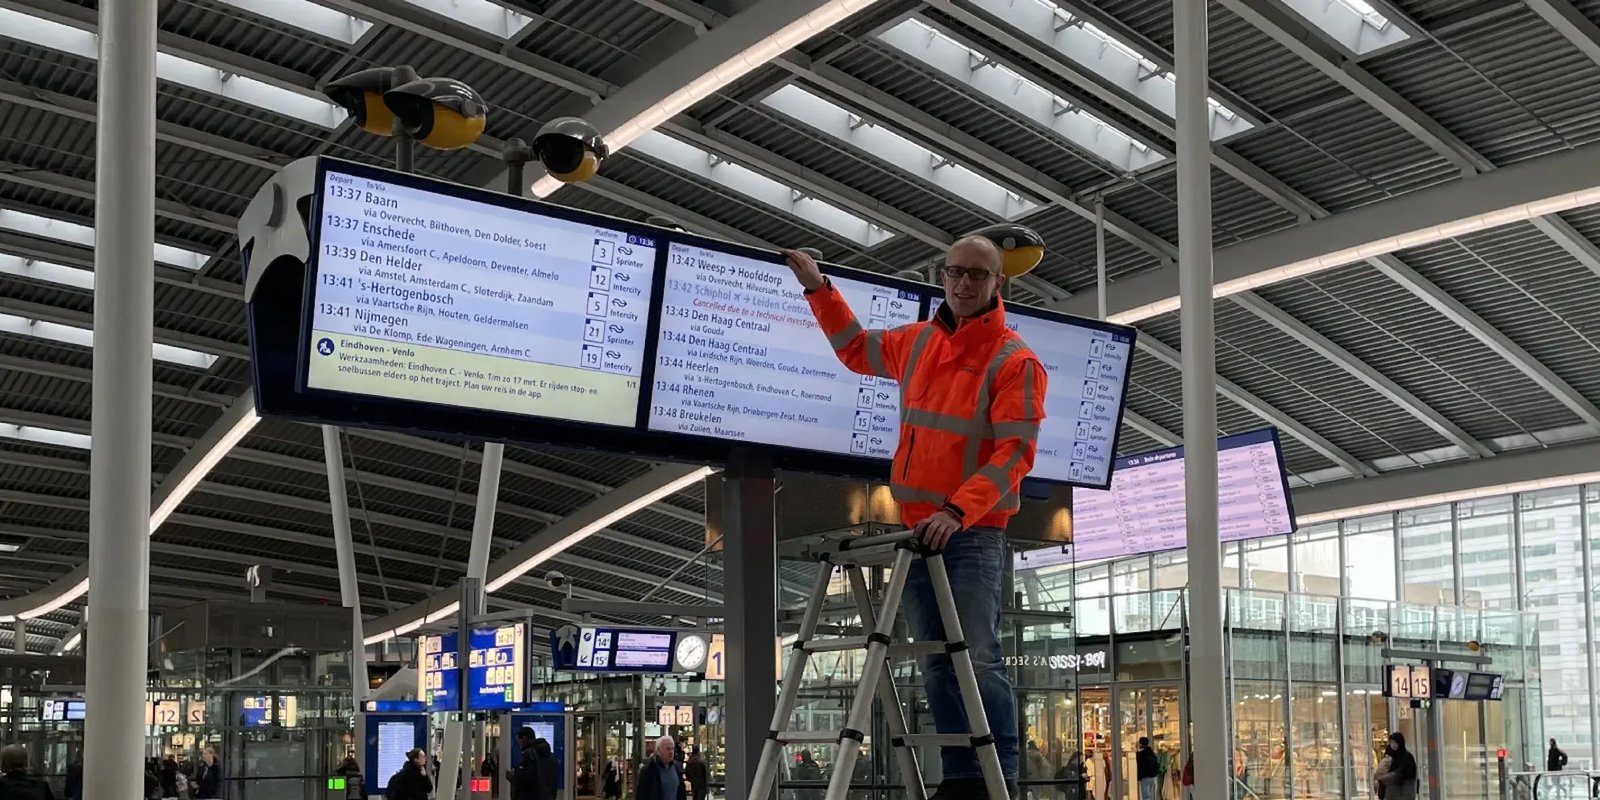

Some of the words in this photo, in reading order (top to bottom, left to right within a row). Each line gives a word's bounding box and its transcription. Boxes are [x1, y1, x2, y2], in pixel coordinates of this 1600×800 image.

[330, 174, 353, 184] Depart
[331, 185, 361, 200] 13:37
[365, 192, 398, 208] Baarn
[328, 215, 359, 230] 13:37
[363, 221, 415, 241] Enschede
[364, 208, 377, 218] via
[380, 210, 426, 229] Overvecht,
[430, 220, 472, 238] Bilthoven,
[475, 229, 491, 240] Den
[493, 232, 521, 247] Dolder,
[524, 239, 546, 251] Soest
[326, 245, 356, 260] 13:39
[360, 250, 382, 264] Den
[386, 255, 422, 271] Helder
[361, 237, 374, 247] via
[377, 240, 427, 257] Amersfoort
[442, 252, 488, 269] Apeldoorn,
[491, 260, 529, 276] Deventer,
[531, 269, 559, 281] Almelo
[600, 248, 606, 258] 3
[616, 257, 643, 268] Sprinter
[672, 254, 695, 267] 13:42
[698, 259, 726, 275] Weesp
[738, 267, 782, 287] Hoofddorp
[596, 274, 606, 285] 12
[708, 275, 743, 290] Overvecht,
[323, 274, 352, 288] 13:41
[359, 279, 453, 305] 's-Hertogenbosch
[359, 268, 372, 276] via
[374, 268, 406, 283] Amstel,
[409, 275, 458, 290] Amsterdam
[474, 285, 515, 302] Sloterdijk,
[517, 293, 553, 307] Zaandam
[613, 284, 641, 296] Intercity
[669, 279, 692, 293] 13:42
[695, 284, 731, 300] Schiphol
[752, 296, 779, 309] Leiden
[595, 301, 600, 311] 5
[693, 298, 728, 311] Cancelled
[728, 305, 740, 314] due
[756, 310, 785, 321] technical
[878, 303, 881, 311] 1
[320, 303, 349, 317] 13:41
[355, 308, 408, 327] Nijmegen
[372, 297, 414, 311] Vaartsche
[417, 304, 435, 316] Rijn,
[438, 308, 471, 322] Houten,
[474, 314, 528, 330] Geldermalsen
[610, 309, 638, 322] Intercity
[666, 305, 689, 318] 13:43
[692, 310, 708, 321] Den
[711, 314, 733, 328] Haag
[735, 318, 770, 332] Centraal
[589, 327, 599, 337] 21
[702, 325, 724, 336] Gouda
[354, 325, 367, 333] via
[369, 325, 381, 335] De
[384, 328, 413, 341] Klomp,
[416, 332, 488, 352] Ede-Wageningen,
[491, 344, 522, 356] Arnhem
[607, 335, 634, 345] Sprinter
[663, 331, 686, 343] 13:44
[689, 335, 706, 346] Den
[708, 338, 730, 353] Haag
[732, 342, 767, 357] Centraal
[341, 340, 384, 353] Eindhoven
[392, 347, 415, 357] Venlo
[587, 353, 597, 364] 19
[660, 356, 683, 368] 13:44
[686, 360, 719, 374] Heerlen
[699, 350, 728, 361] Leidsche
[801, 366, 836, 379] Zoetermeer
[339, 352, 406, 368] Werkzaamheden:
[408, 362, 447, 374] Eindhoven
[540, 380, 547, 388] Er
[548, 383, 569, 391] rijden
[571, 385, 585, 394] stop-
[604, 361, 632, 372] Intercity
[1091, 366, 1095, 374] 7
[338, 366, 381, 376] snelbussen
[383, 370, 407, 380] elders
[409, 375, 419, 383] op
[421, 375, 433, 384] het
[464, 381, 479, 389] Plan
[657, 381, 680, 393] 13:44
[682, 385, 714, 398] Rhenen
[756, 384, 790, 395] Eindhoven
[800, 390, 832, 402] Roermond
[1086, 387, 1093, 395] 12
[693, 399, 725, 411] Vaartsche
[862, 395, 870, 404] 18
[654, 406, 677, 418] 13:48
[680, 409, 722, 423] Breukelen
[859, 418, 867, 427] 15
[714, 426, 745, 437] Maarssen
[1078, 428, 1086, 436] 21
[856, 440, 863, 449] 14
[1076, 448, 1083, 456] 19
[597, 638, 610, 648] 14
[595, 656, 608, 666] 15
[1050, 651, 1106, 672] SISSY-BOY
[1395, 677, 1408, 694] 14
[1414, 678, 1428, 695] 15
[159, 710, 176, 723] 12
[662, 712, 672, 724] 11
[679, 711, 690, 724] 12
